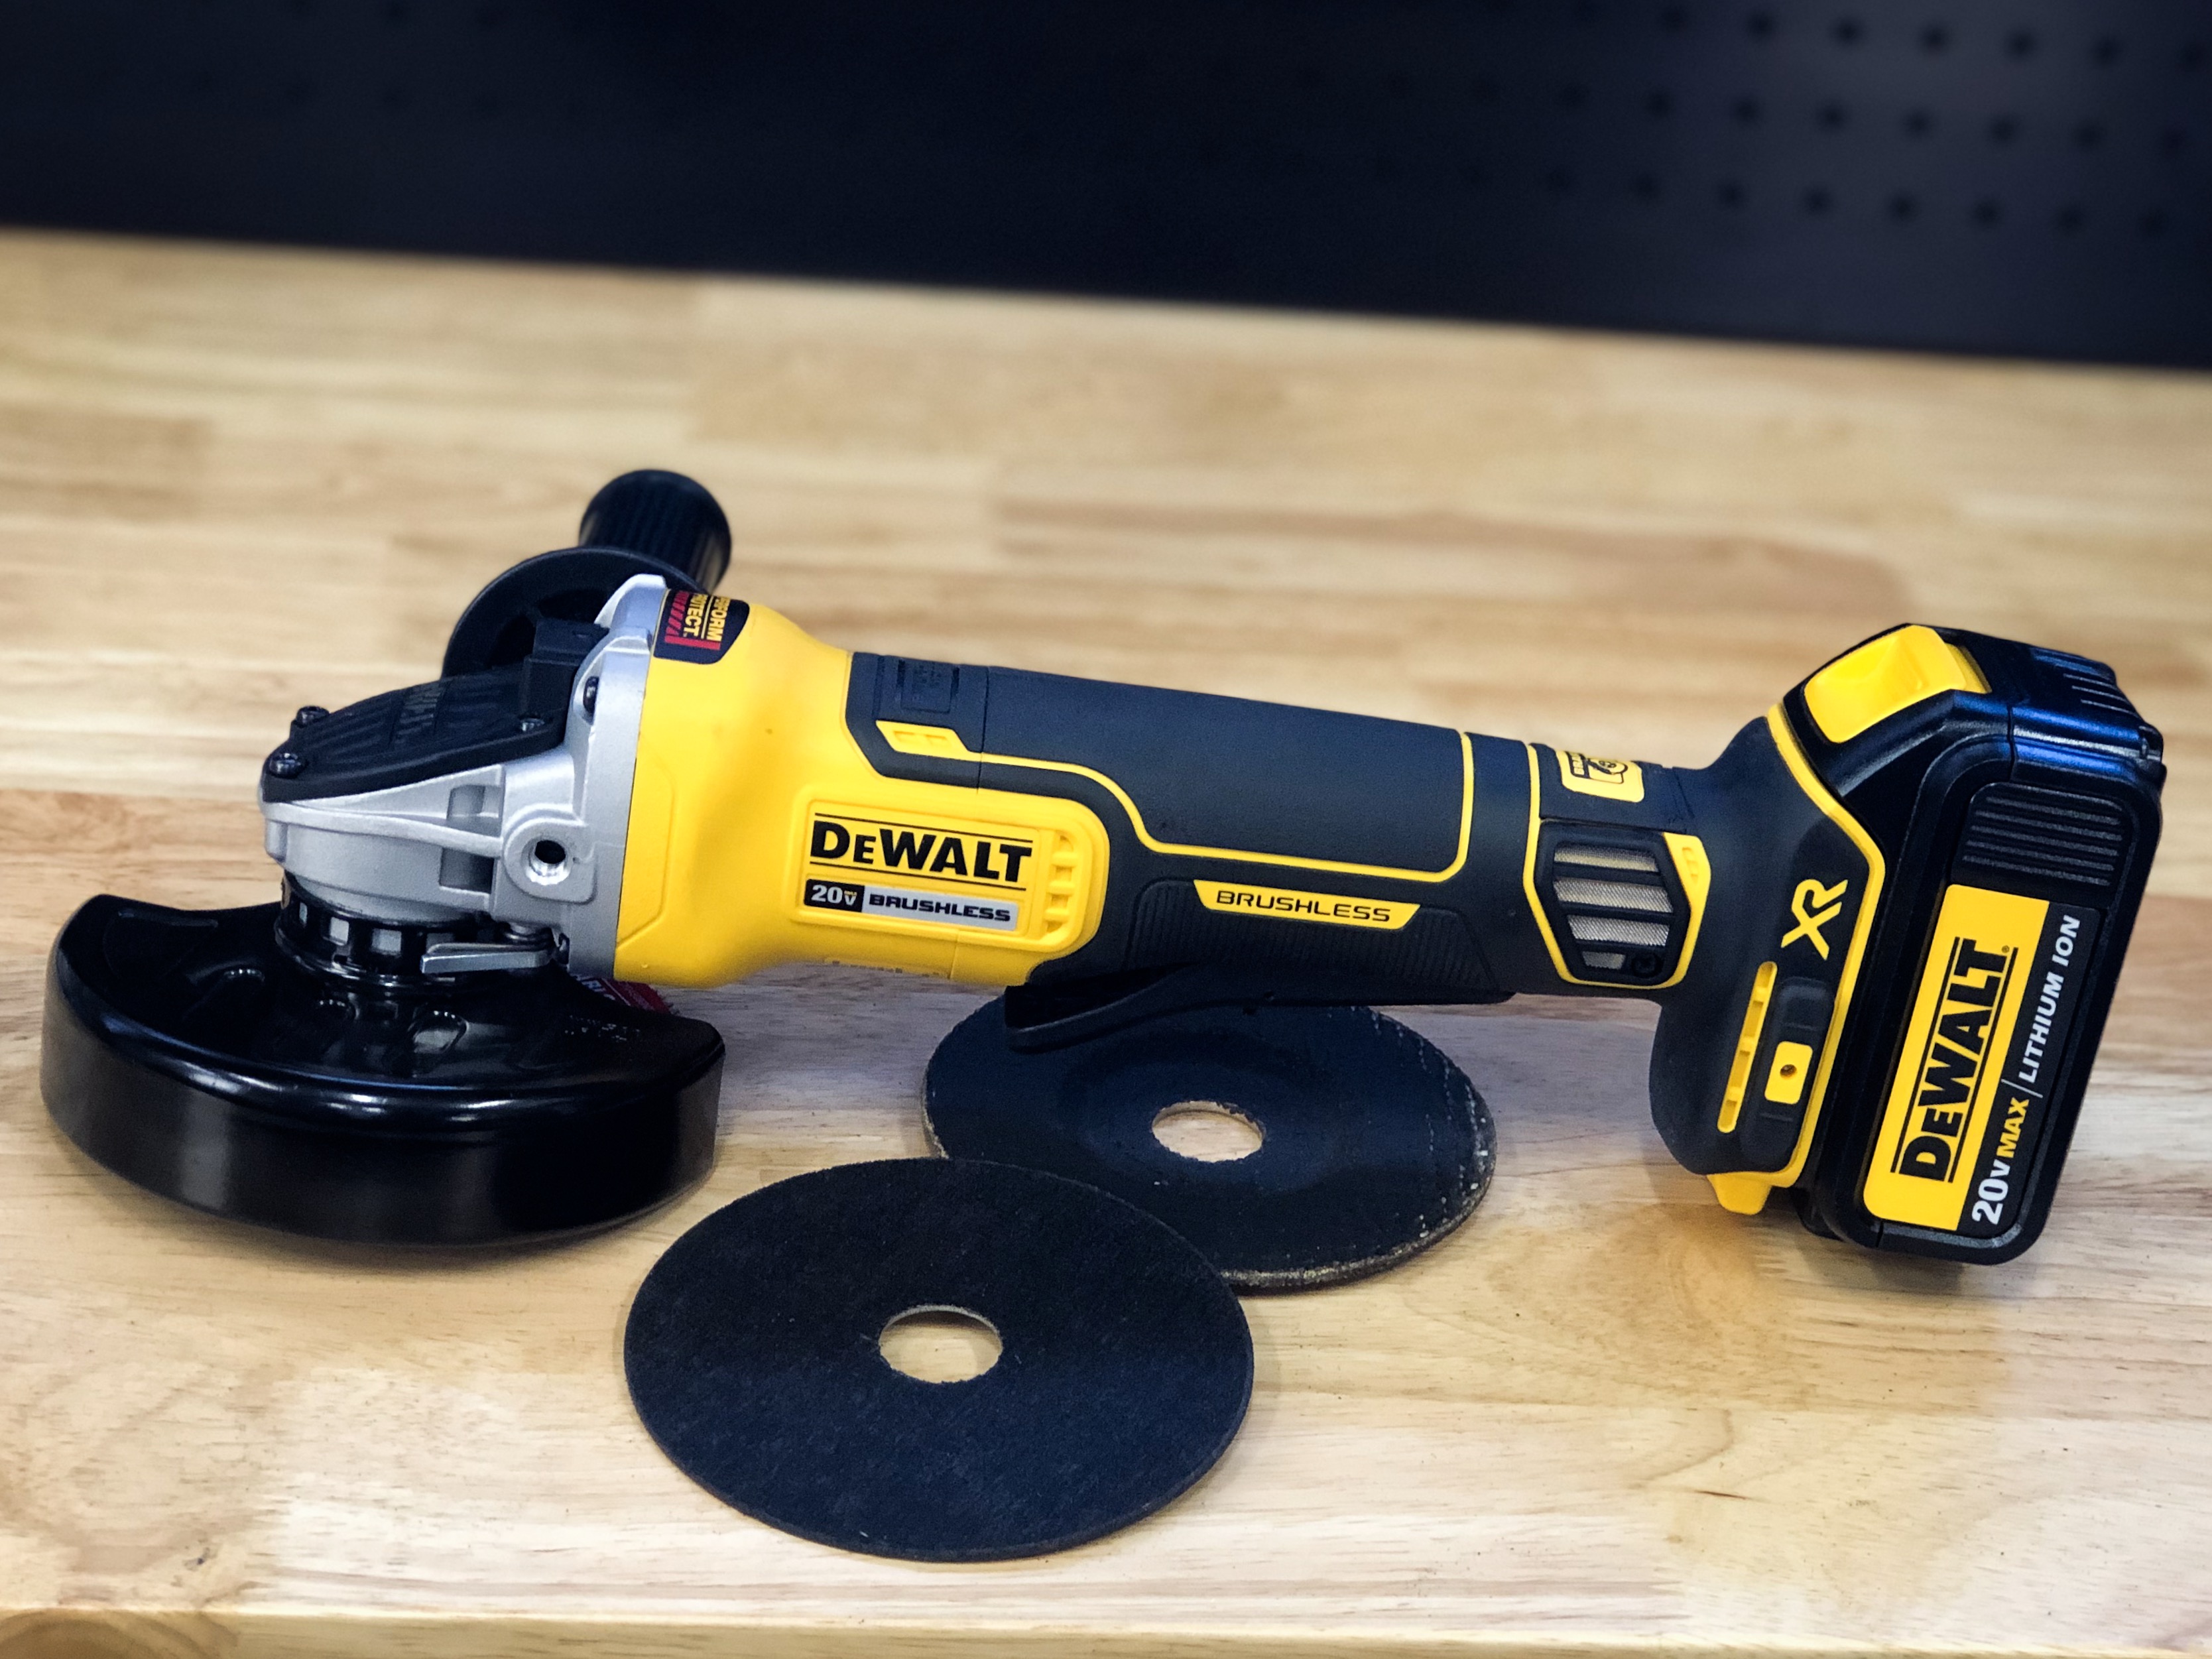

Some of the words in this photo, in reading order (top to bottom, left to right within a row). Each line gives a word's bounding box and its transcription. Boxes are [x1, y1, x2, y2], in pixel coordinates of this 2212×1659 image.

[811, 884, 857, 906] 20V
[869, 893, 1011, 922] BRUSHLESS
[1216, 890, 1391, 922] BRUSHLESS
[1780, 879, 1849, 961] XR
[1971, 1159, 2011, 1225] 20V
[1996, 1097, 2030, 1158] MAX
[2018, 971, 2065, 1083] LITHIUM
[2052, 914, 2081, 967] ION
